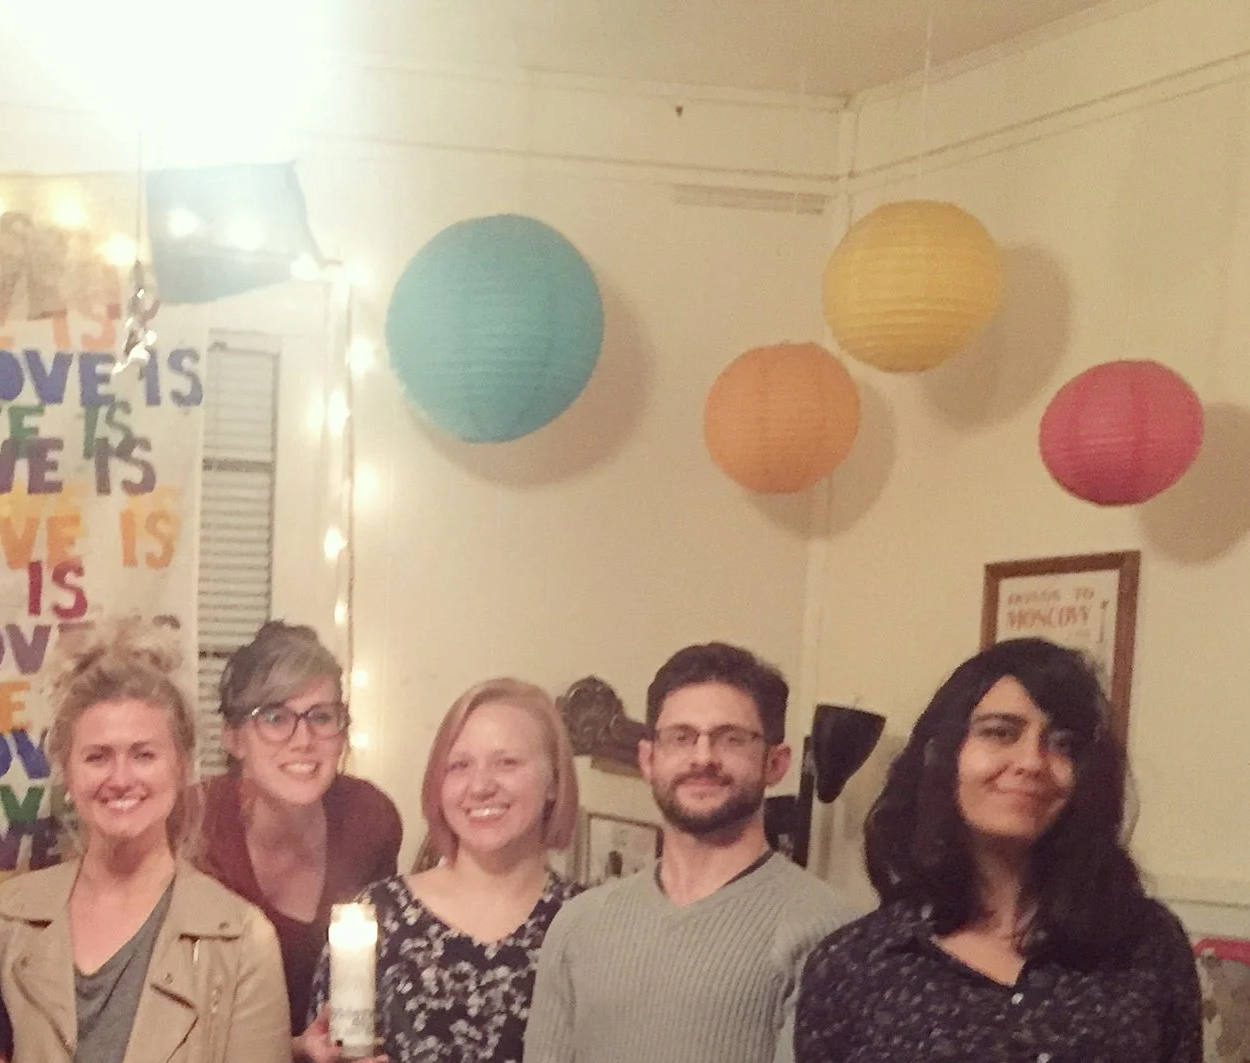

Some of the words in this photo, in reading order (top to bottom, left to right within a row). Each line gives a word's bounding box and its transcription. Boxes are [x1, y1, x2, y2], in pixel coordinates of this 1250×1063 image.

[143, 345, 204, 408] IS
[93, 437, 156, 494] IS
[119, 509, 175, 570] IS
[28, 560, 88, 620] IS
